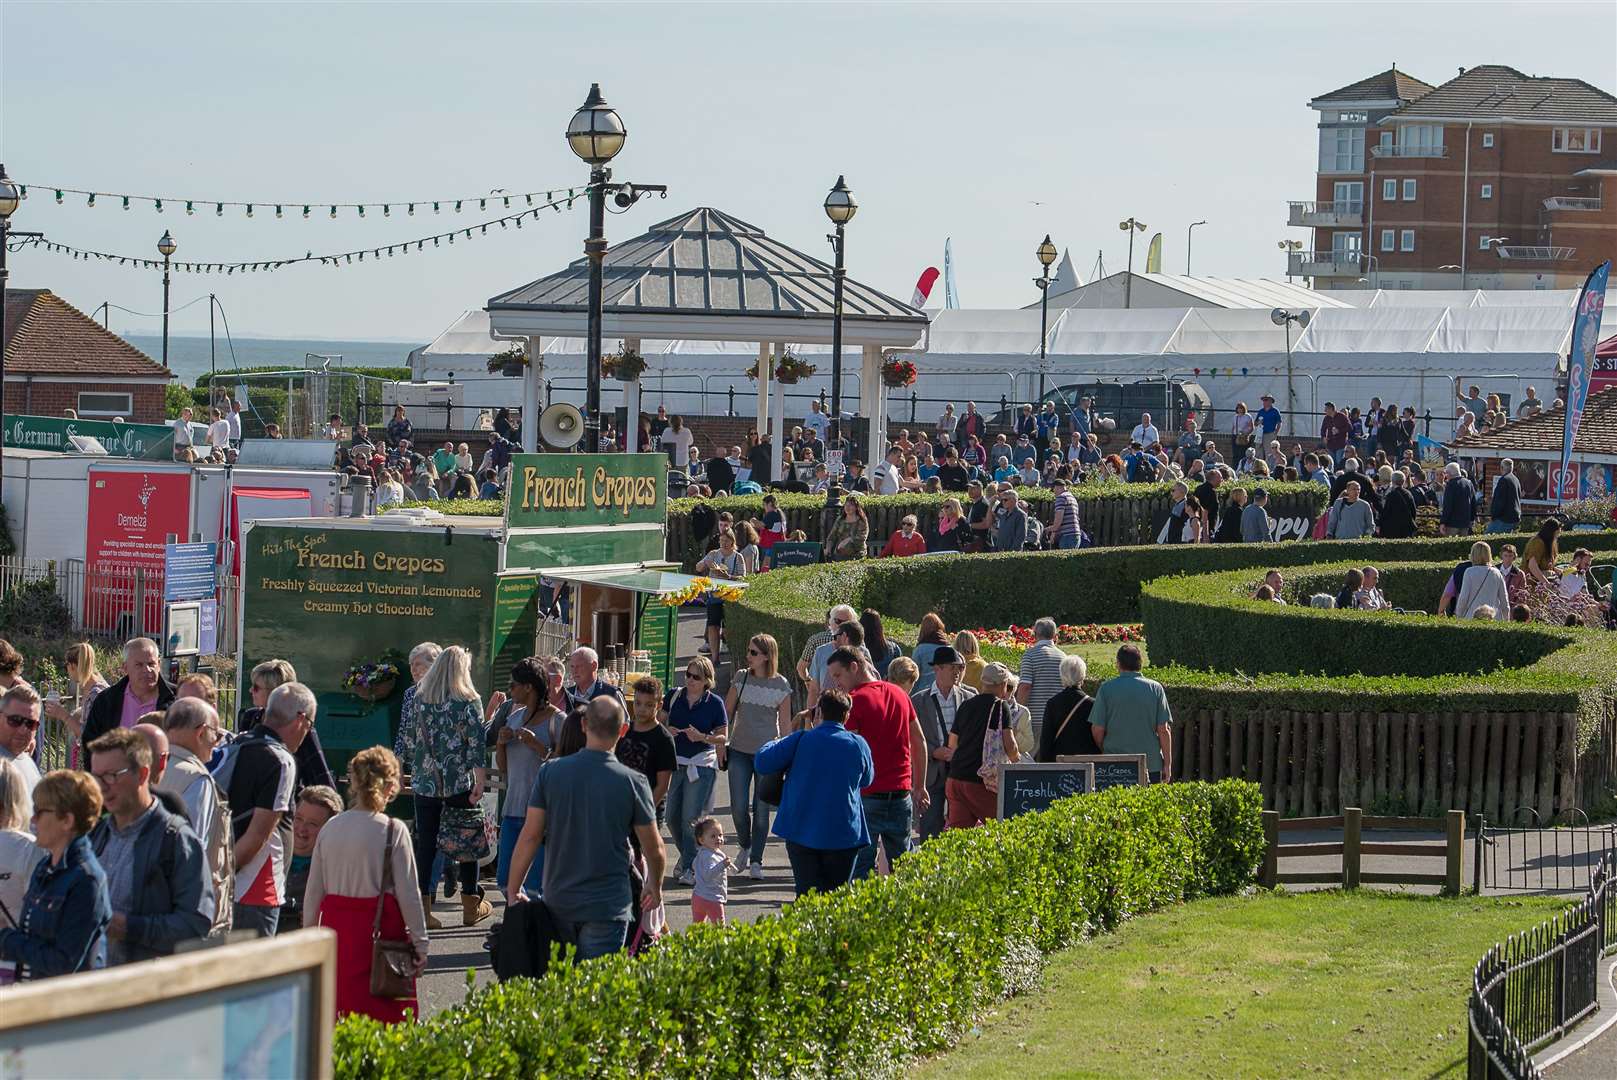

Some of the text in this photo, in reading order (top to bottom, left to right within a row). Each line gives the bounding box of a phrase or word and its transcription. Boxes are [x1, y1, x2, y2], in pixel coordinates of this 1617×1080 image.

[14, 418, 61, 444] German
[64, 424, 120, 455] Sage
[124, 428, 146, 452] Co.
[521, 465, 657, 516] French Crepes
[118, 514, 146, 527] Demelza
[262, 533, 327, 557] Hits The Spot
[297, 548, 446, 576] French Crepes
[262, 578, 481, 598] Freshly Squeezed Victorian Lemonade
[303, 600, 350, 615] Creamy
[375, 602, 434, 616] Chocolate
[1013, 779, 1057, 800] Freshly
